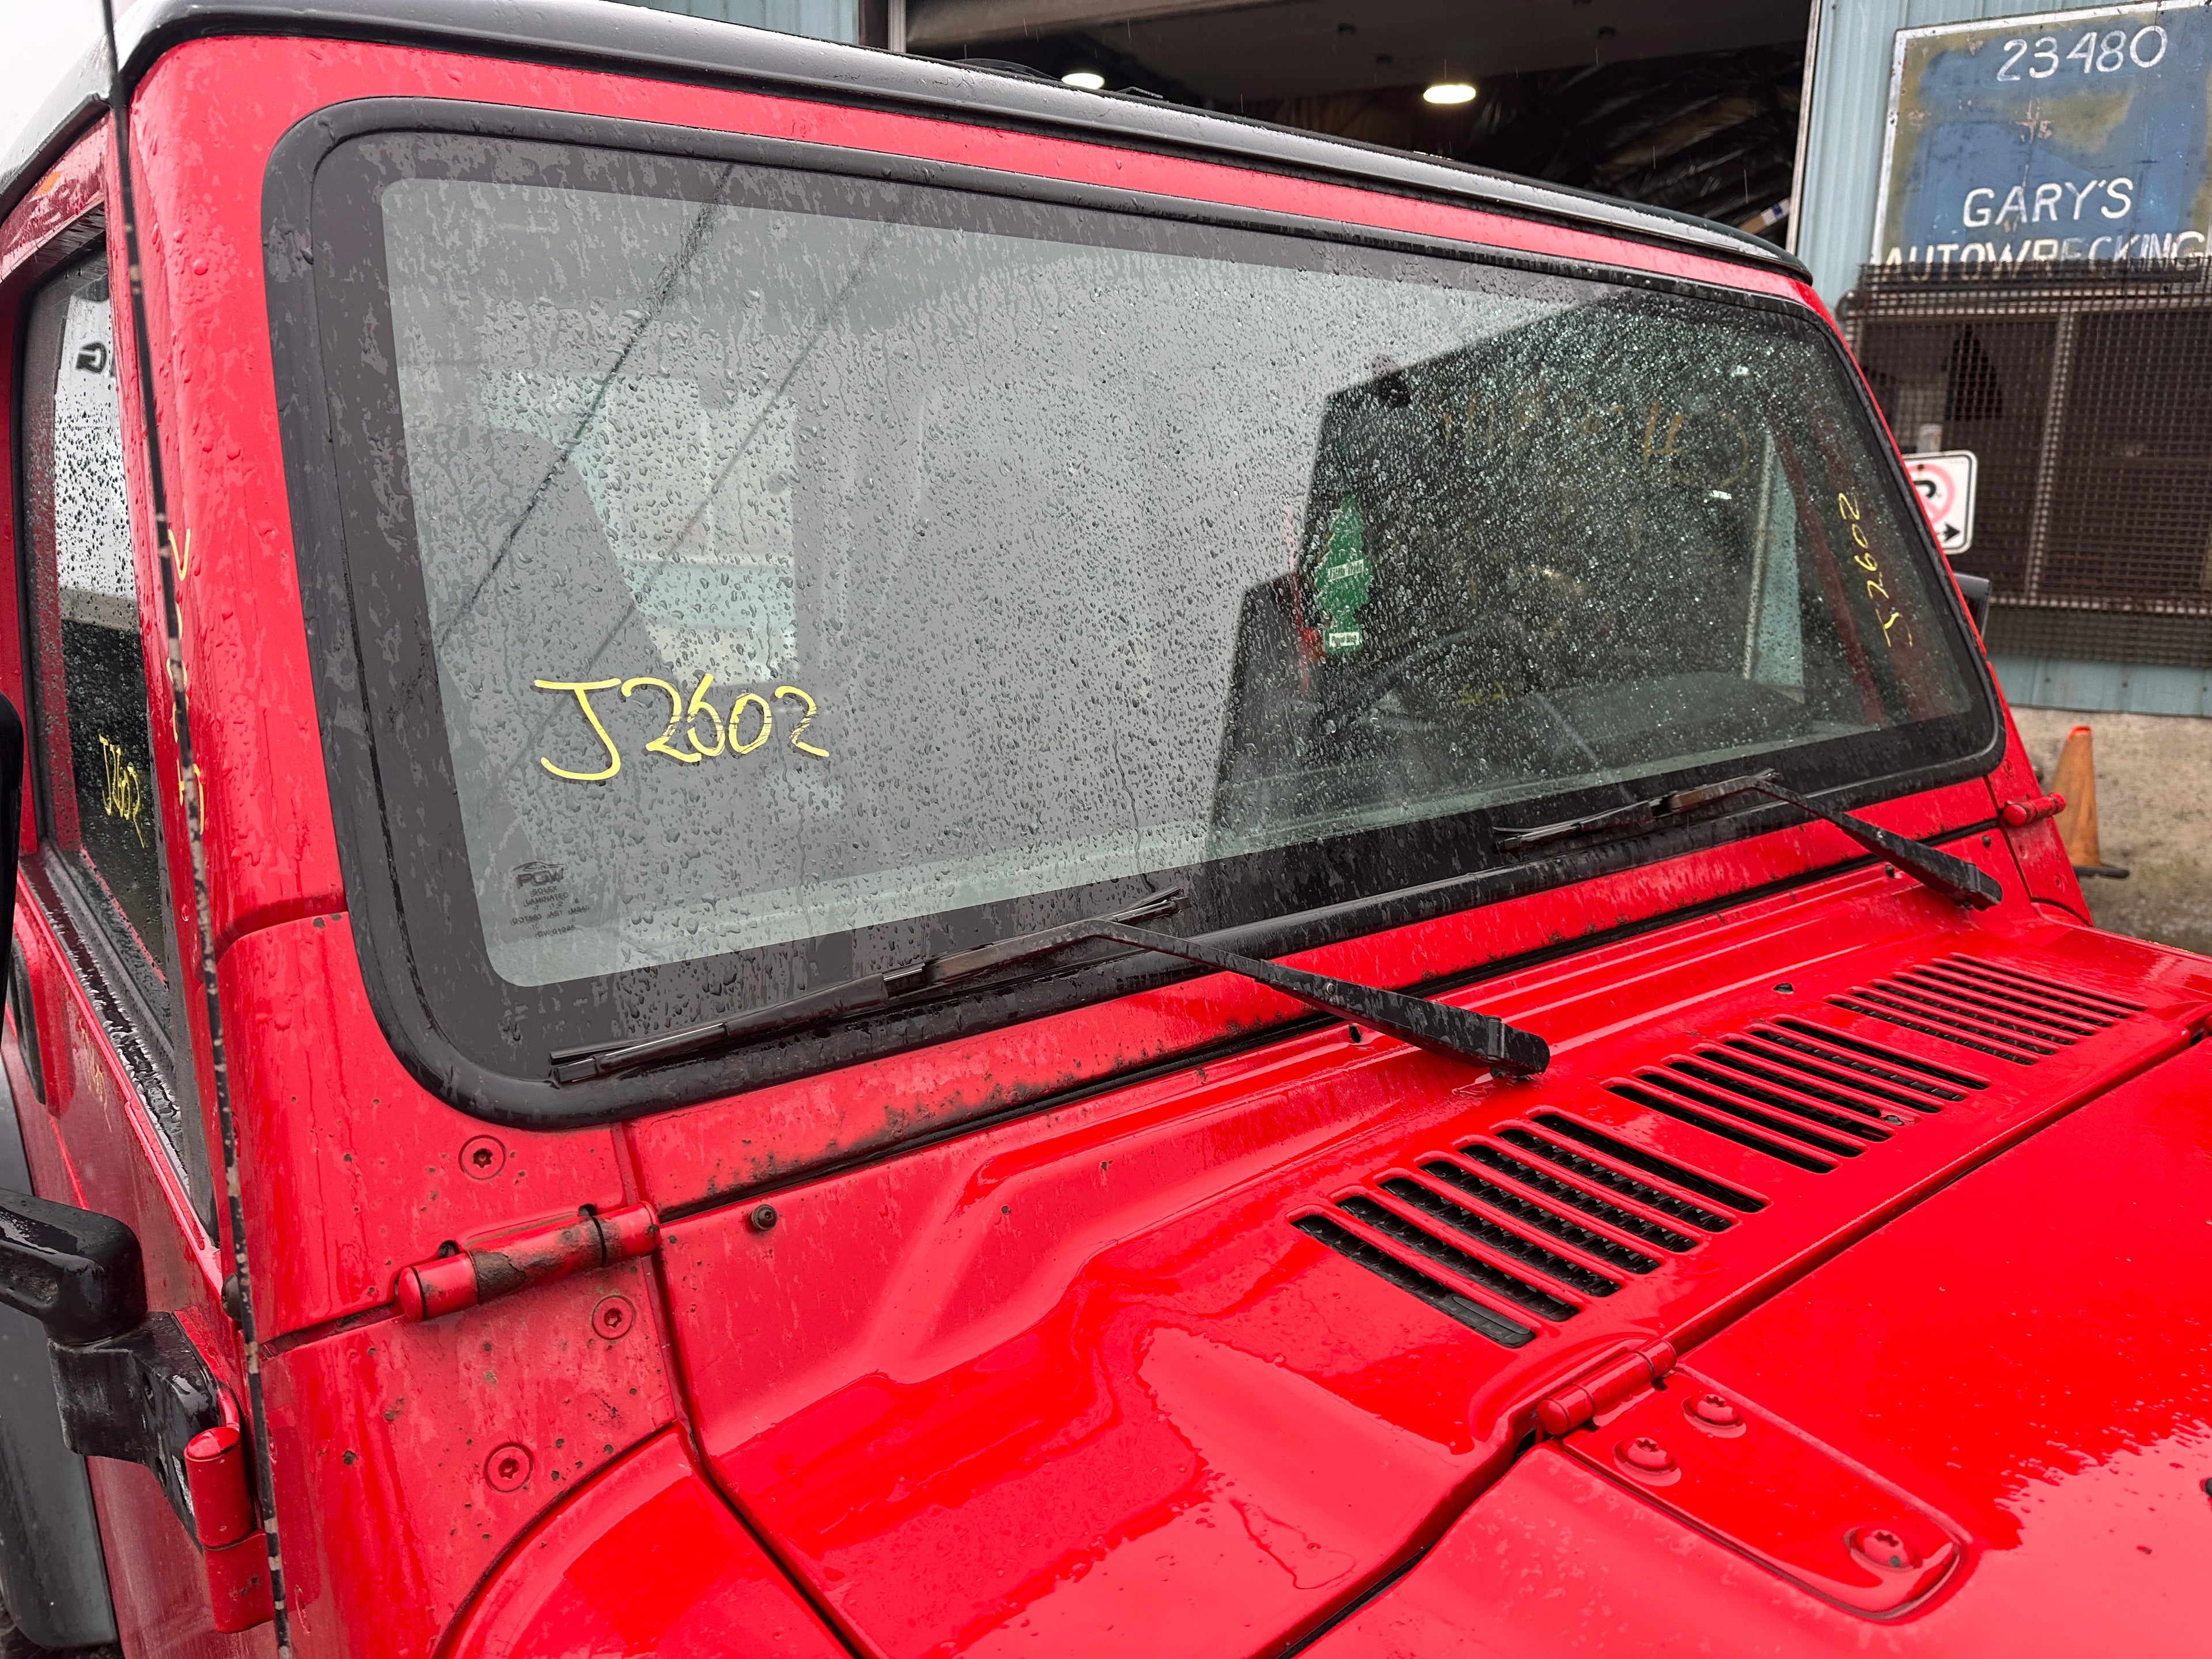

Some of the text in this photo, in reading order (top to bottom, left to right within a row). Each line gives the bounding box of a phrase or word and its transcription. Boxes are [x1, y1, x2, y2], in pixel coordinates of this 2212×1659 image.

[1997, 25, 2168, 82] 23480
[1963, 176, 2133, 228] GARY'S
[533, 673, 830, 782] J2602
[523, 892, 569, 907] LAMINATED
